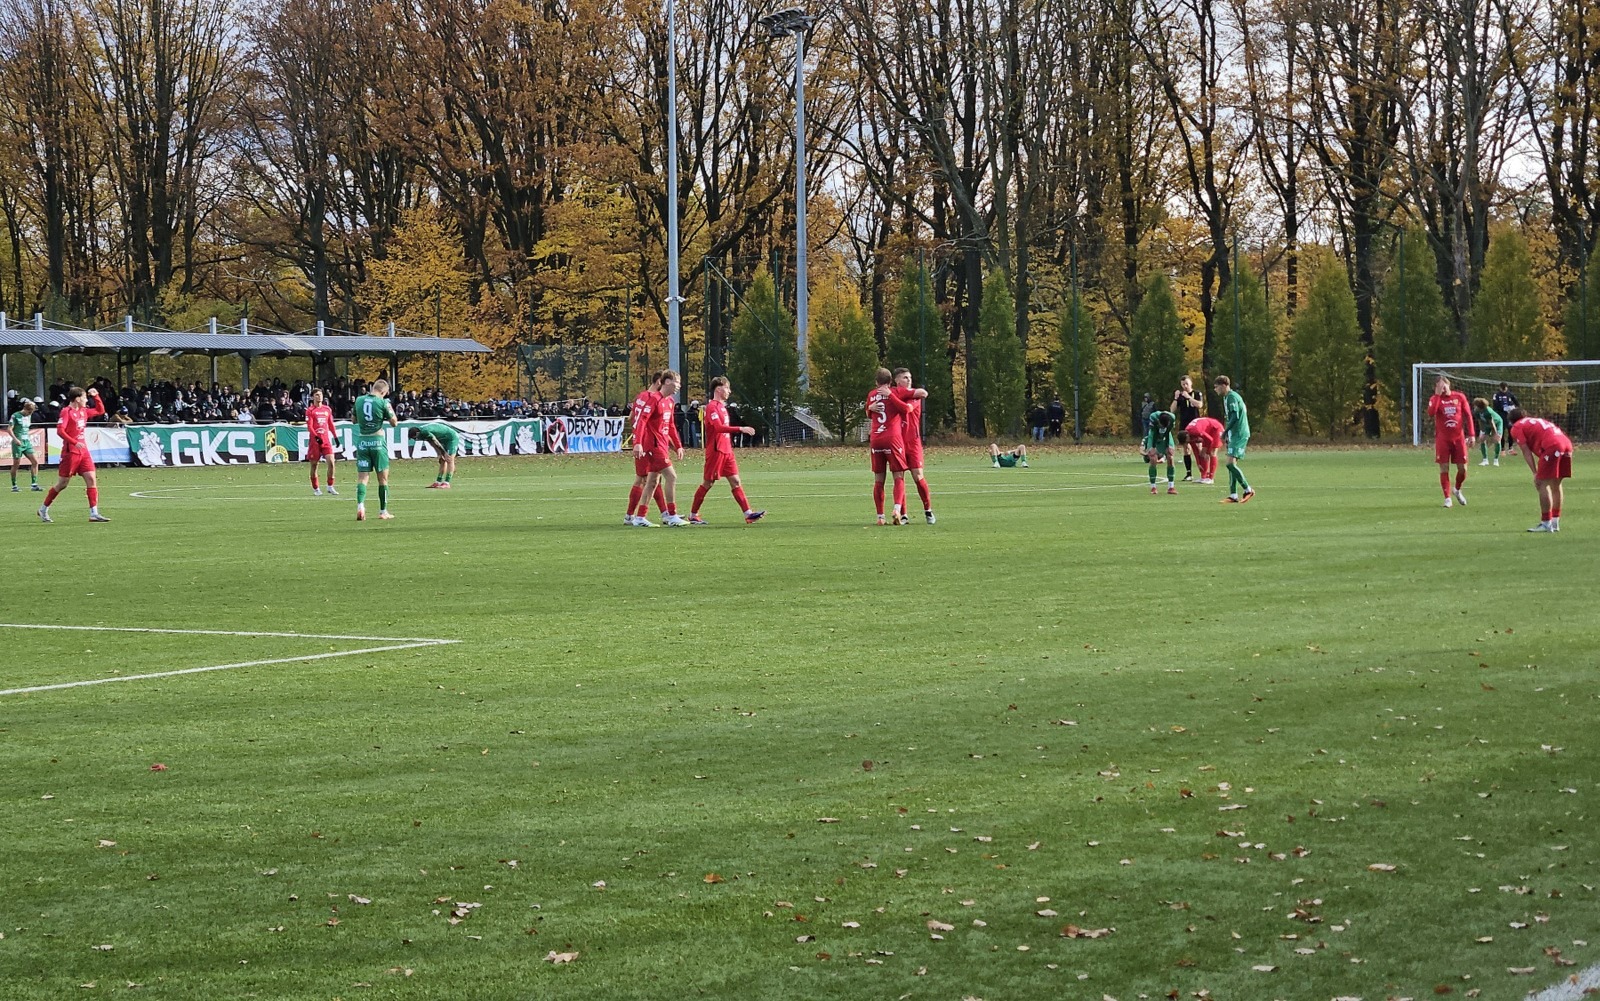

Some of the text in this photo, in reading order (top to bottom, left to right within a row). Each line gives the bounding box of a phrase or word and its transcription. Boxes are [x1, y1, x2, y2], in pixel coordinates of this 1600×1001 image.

[363, 401, 373, 421] 9
[567, 418, 600, 435] DERBY
[171, 430, 258, 465] GKS
